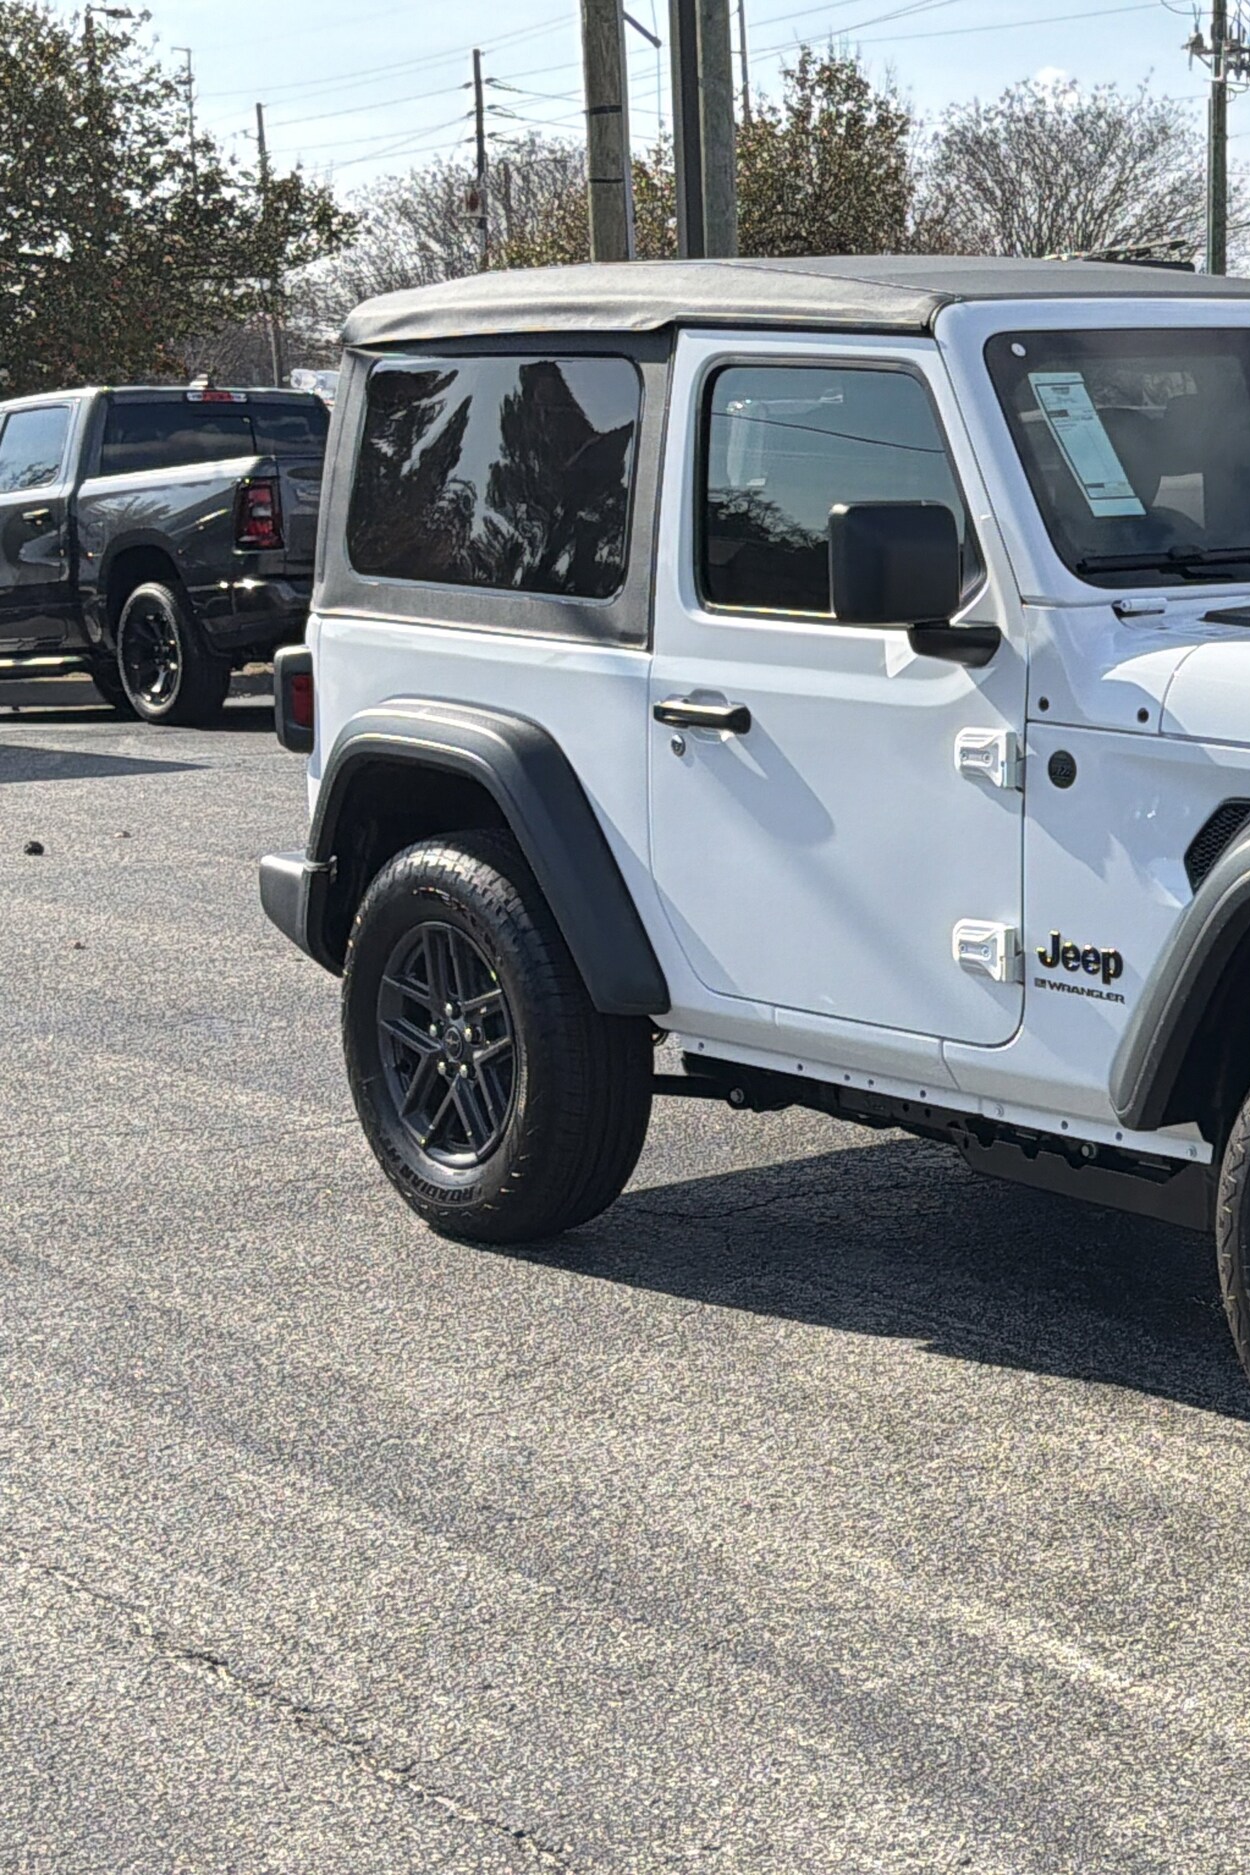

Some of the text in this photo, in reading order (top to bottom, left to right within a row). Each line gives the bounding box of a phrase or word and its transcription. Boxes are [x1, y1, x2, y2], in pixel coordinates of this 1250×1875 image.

[1035, 929, 1124, 985] Jeep
[1047, 979, 1126, 1004] WRANGLER
[400, 1163, 476, 1201] ROADIAN
